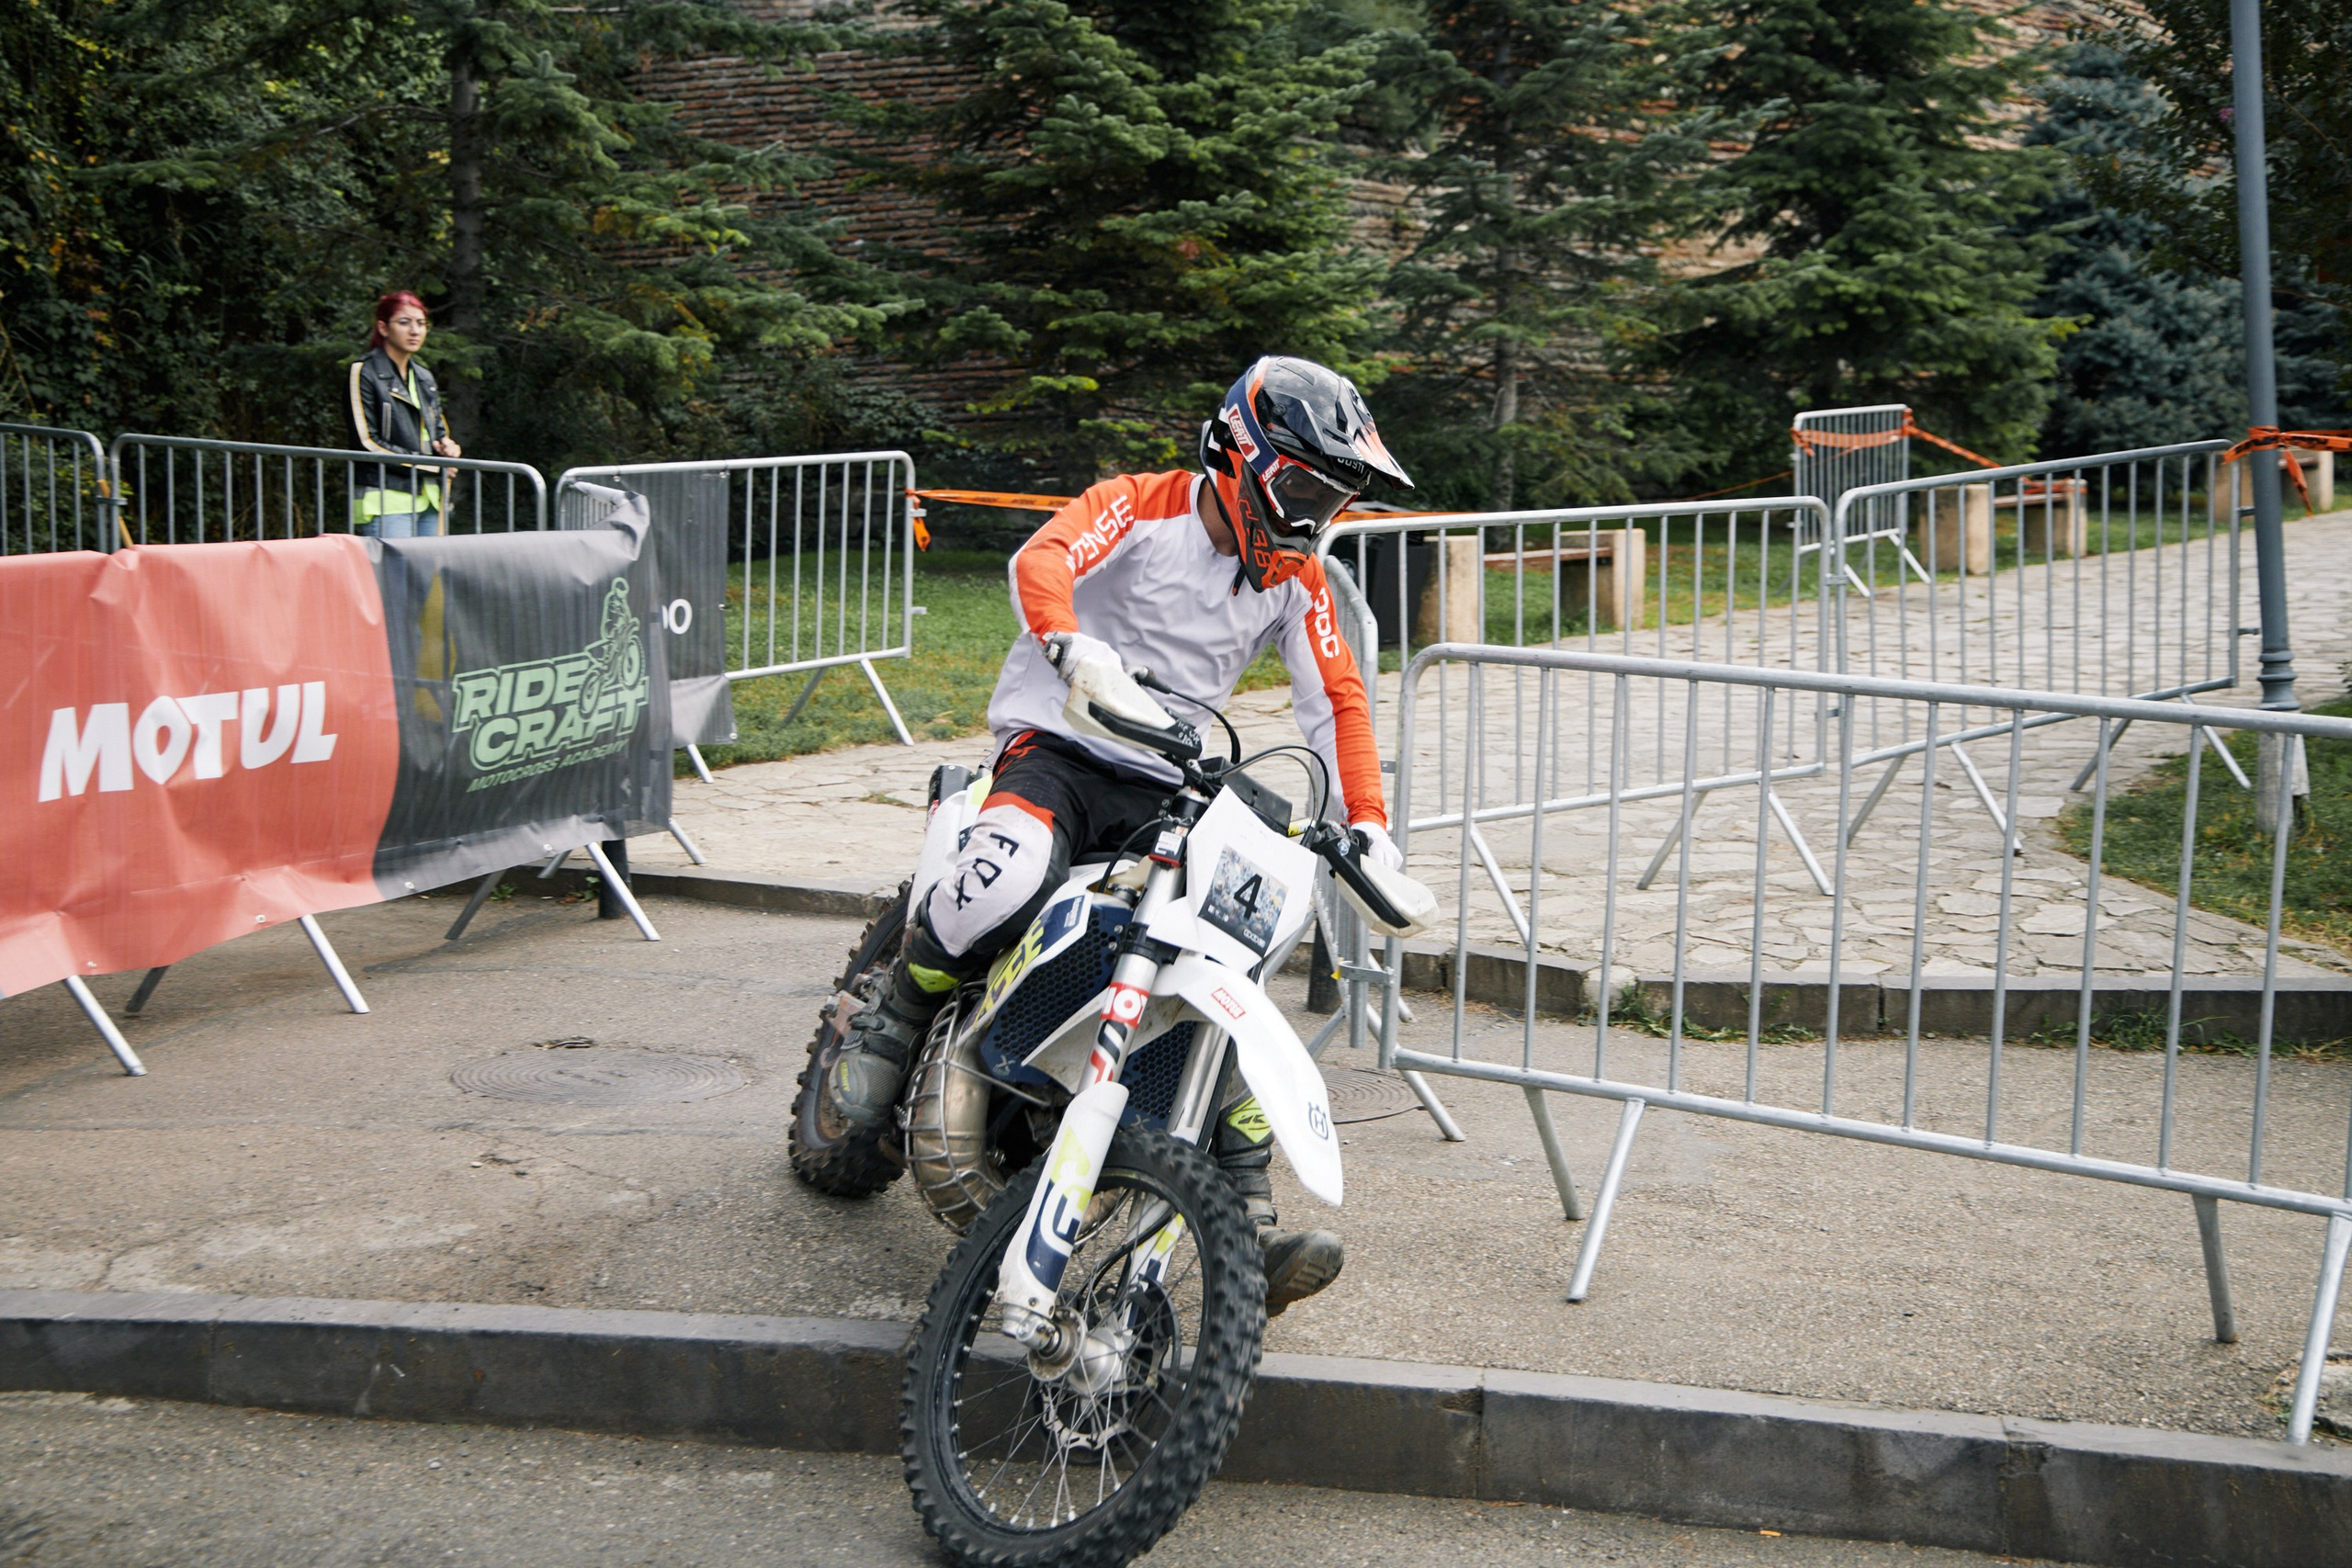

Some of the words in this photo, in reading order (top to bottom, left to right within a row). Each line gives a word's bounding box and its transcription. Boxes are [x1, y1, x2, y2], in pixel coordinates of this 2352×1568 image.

[1229, 413, 1252, 447] LEATT
[1261, 460, 1282, 482] LEATT
[456, 656, 594, 725] RIDE
[38, 681, 338, 803] MOTUL
[472, 683, 648, 766] CRAFT
[466, 756, 560, 794] MOTOCROSS
[559, 739, 630, 768] ACADEMY
[1233, 873, 1263, 921] 4
[1212, 988, 1245, 1019] MOTUL
